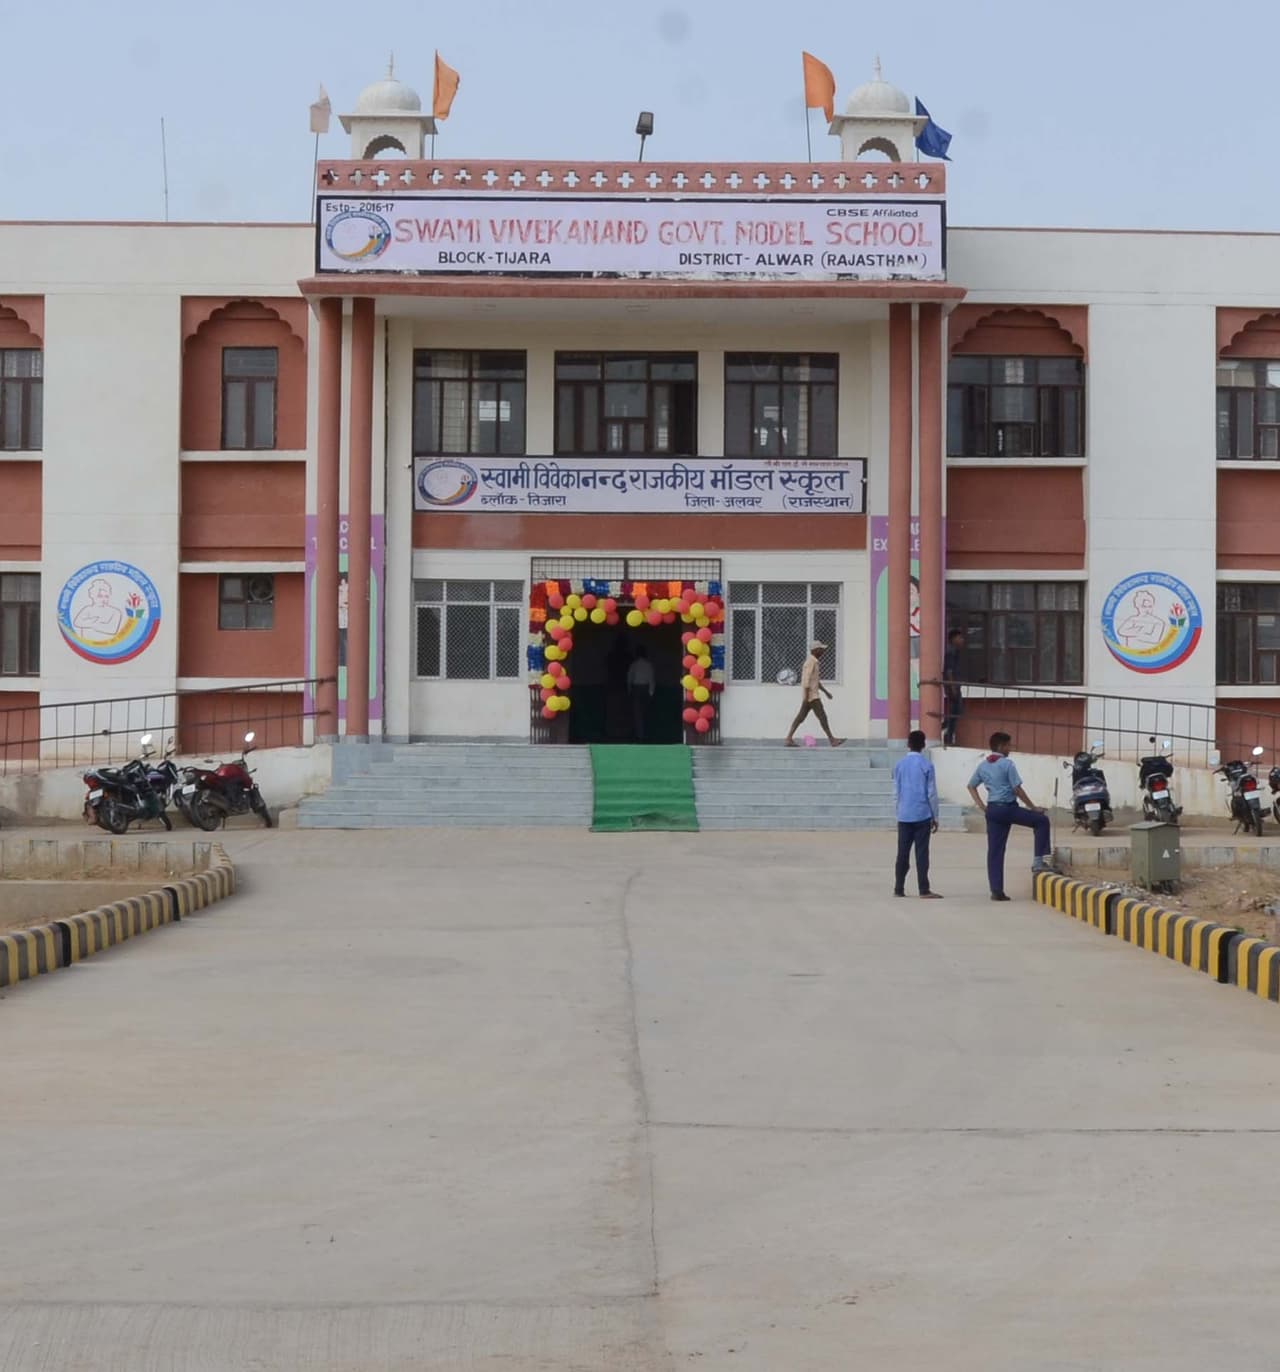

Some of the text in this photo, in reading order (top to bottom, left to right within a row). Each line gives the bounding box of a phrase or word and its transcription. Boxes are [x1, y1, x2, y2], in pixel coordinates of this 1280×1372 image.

[360, 202, 395, 213] 2016-17
[826, 208, 919, 218] CBSE Affiliated
[394, 218, 481, 243] SWAMI
[489, 219, 649, 245] VIVEKANAND
[658, 220, 727, 246] GOVT.
[735, 221, 814, 246] MODEL
[825, 221, 933, 247] SCHOOL
[755, 253, 814, 266] ALWAR
[480, 462, 529, 490] स्वामी
[532, 462, 628, 494] विवेकानन्द
[629, 463, 706, 491] राजकीय
[710, 463, 776, 491] मॉडल
[778, 468, 851, 496] स्कूल
